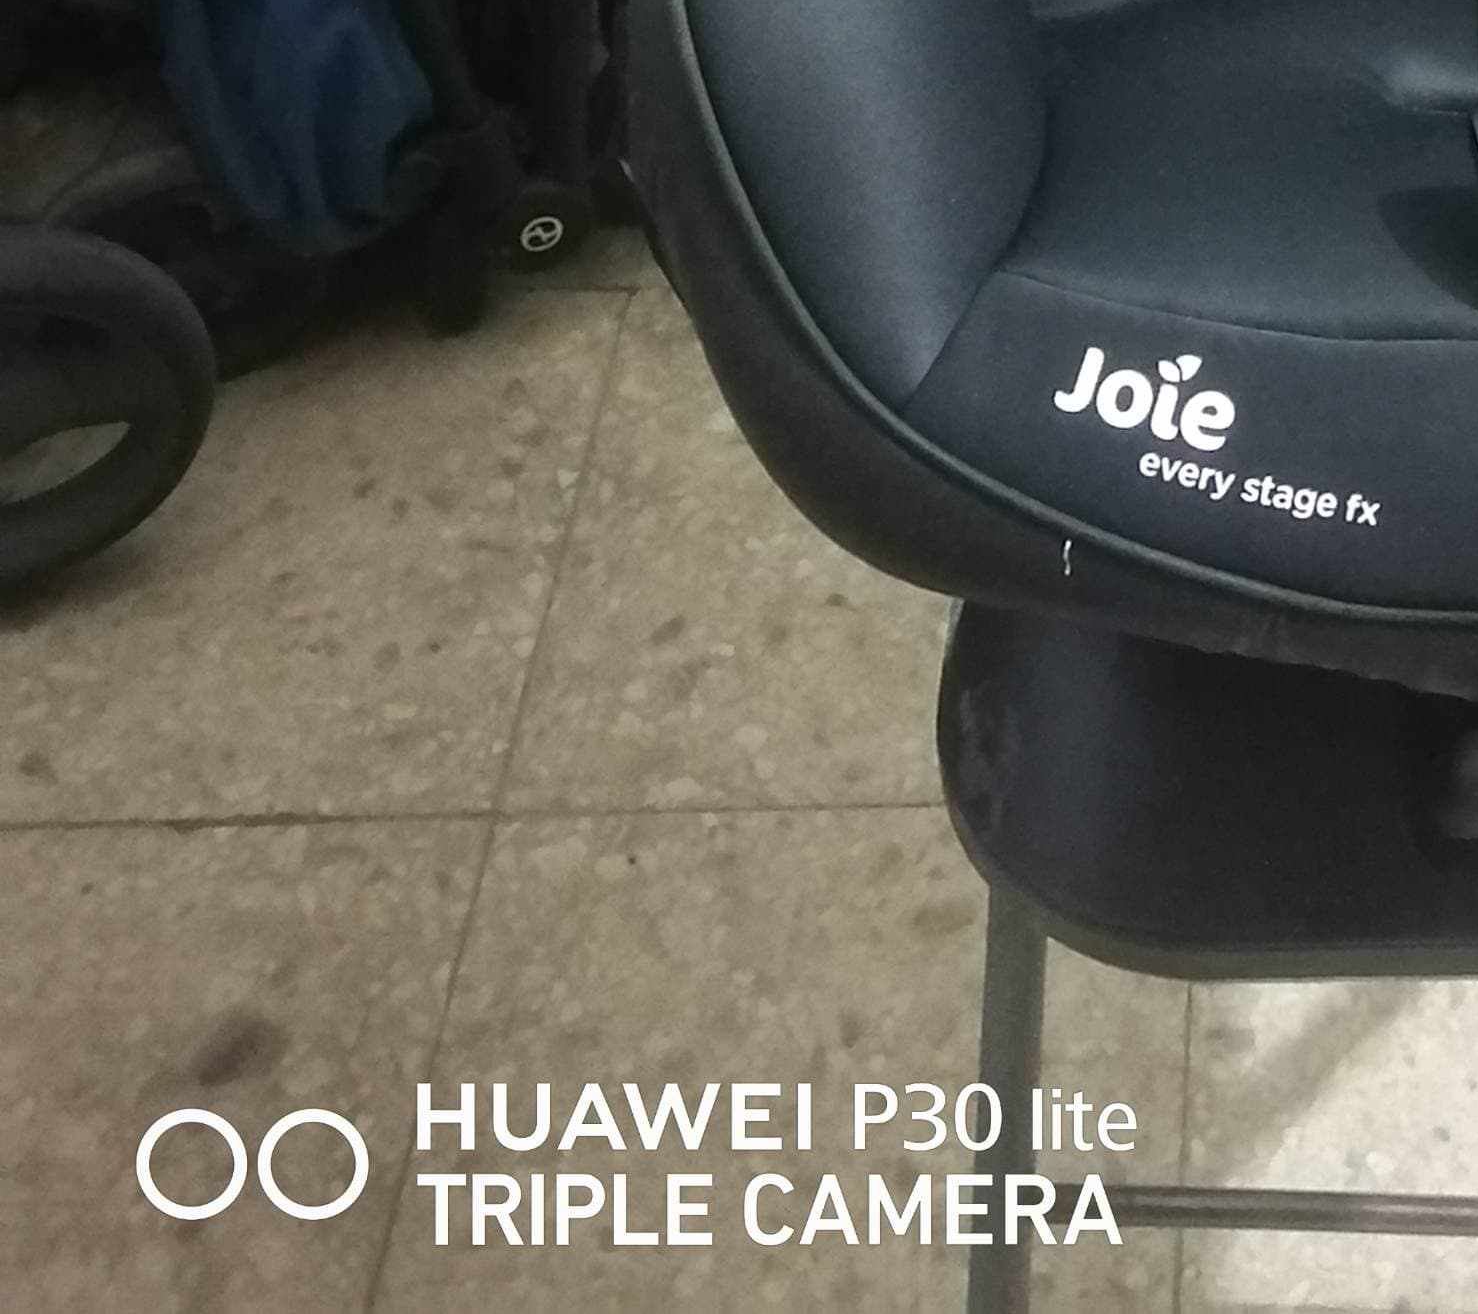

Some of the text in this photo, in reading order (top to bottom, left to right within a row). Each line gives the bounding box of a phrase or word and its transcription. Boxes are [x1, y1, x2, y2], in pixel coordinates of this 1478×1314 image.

[1053, 347, 1236, 451] Joie
[1139, 451, 1382, 526] every stage fx
